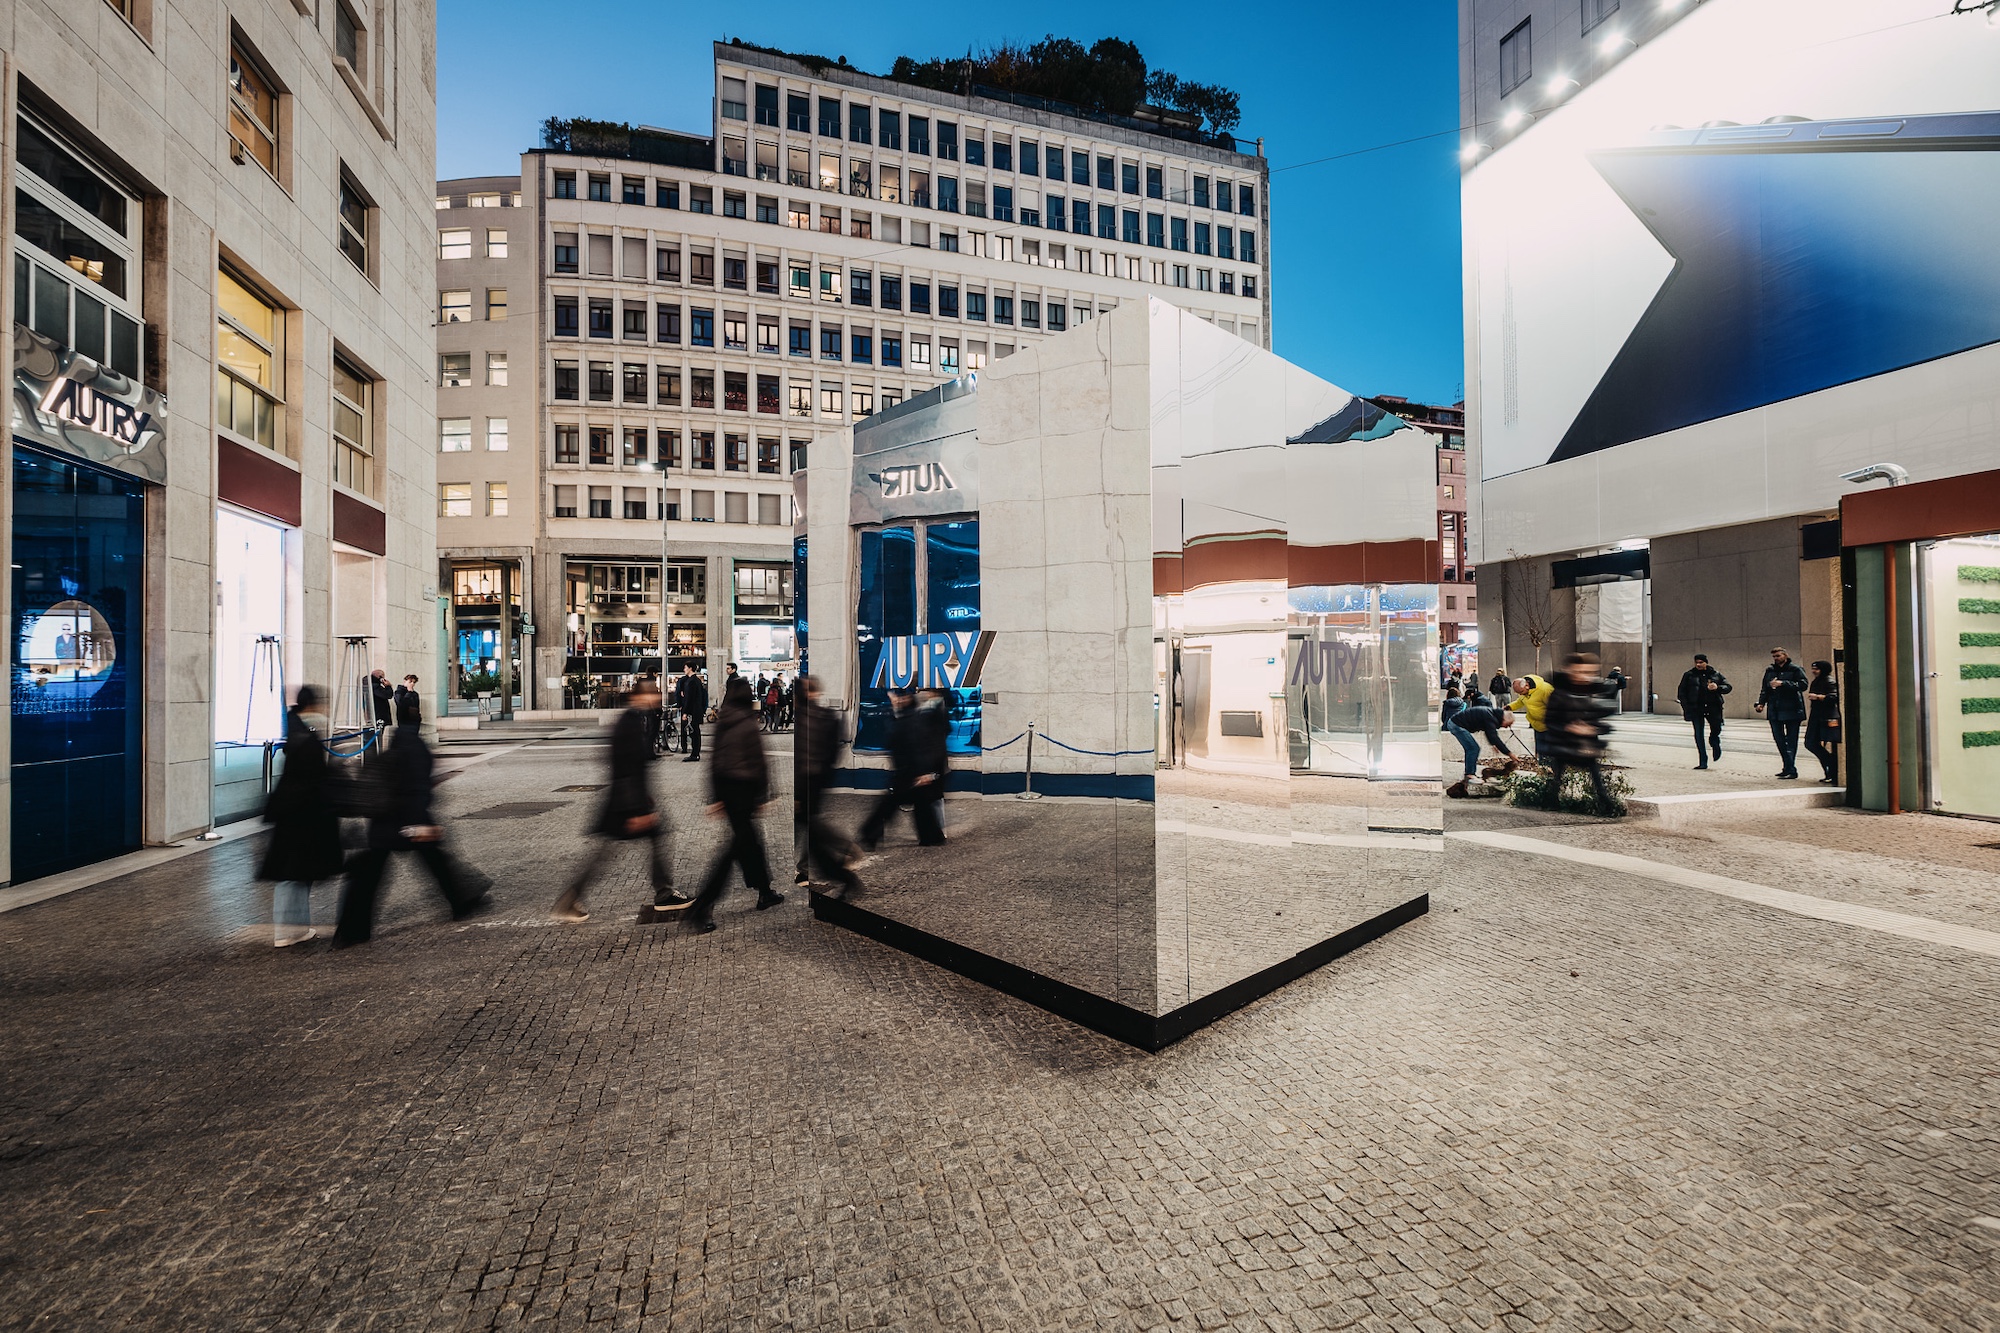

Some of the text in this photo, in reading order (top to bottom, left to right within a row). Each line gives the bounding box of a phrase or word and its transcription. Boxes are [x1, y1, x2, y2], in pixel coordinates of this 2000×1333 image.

[40, 376, 152, 445] AUTRY
[869, 630, 983, 689] AUTRY
[1291, 640, 1363, 686] AUTRY
